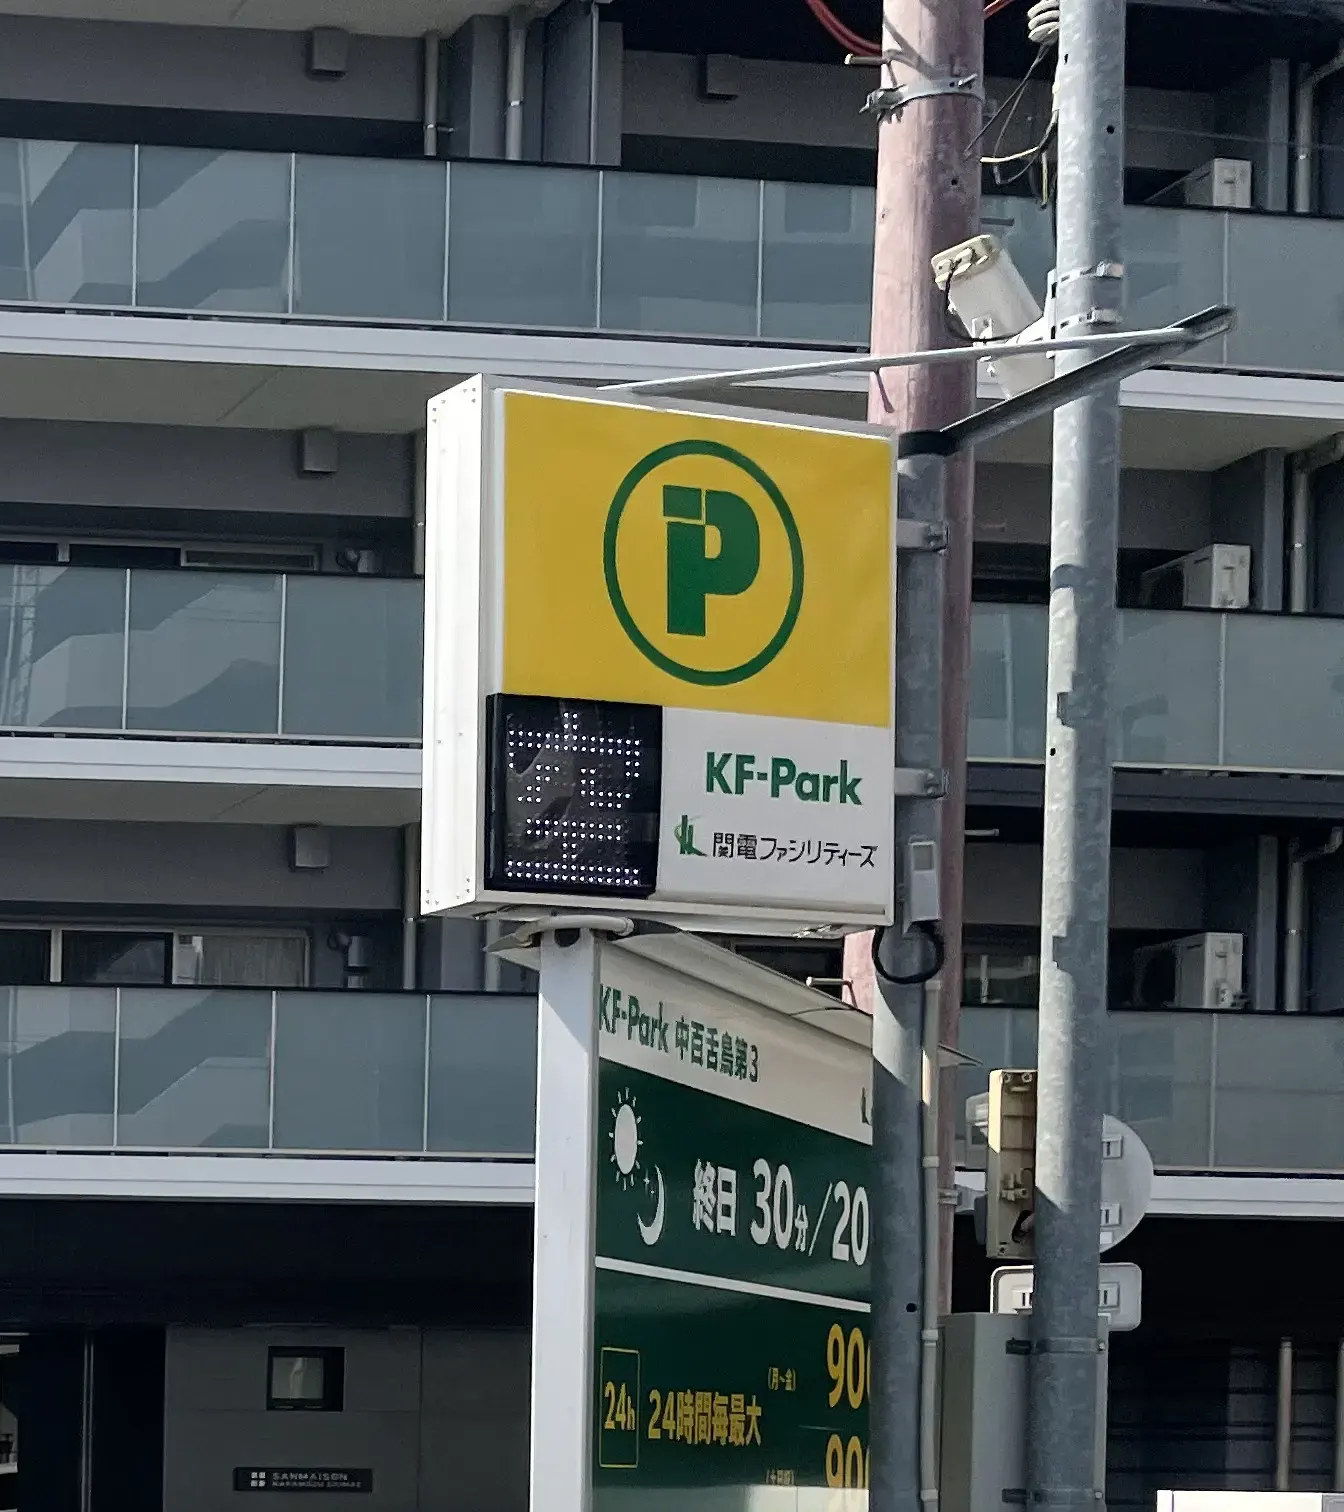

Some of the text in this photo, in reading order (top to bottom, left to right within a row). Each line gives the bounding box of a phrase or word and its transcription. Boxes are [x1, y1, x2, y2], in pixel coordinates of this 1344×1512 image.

[706, 751, 862, 806] KF-Park
[712, 832, 879, 868] 関電ファシリティーズ
[599, 984, 759, 1083] KF-Park 中百舌鳥第3
[692, 1158, 738, 1237] 終日
[604, 1381, 636, 1431] 24h
[648, 1388, 763, 1448] 24時間毎最大
[827, 1322, 870, 1410] 90
